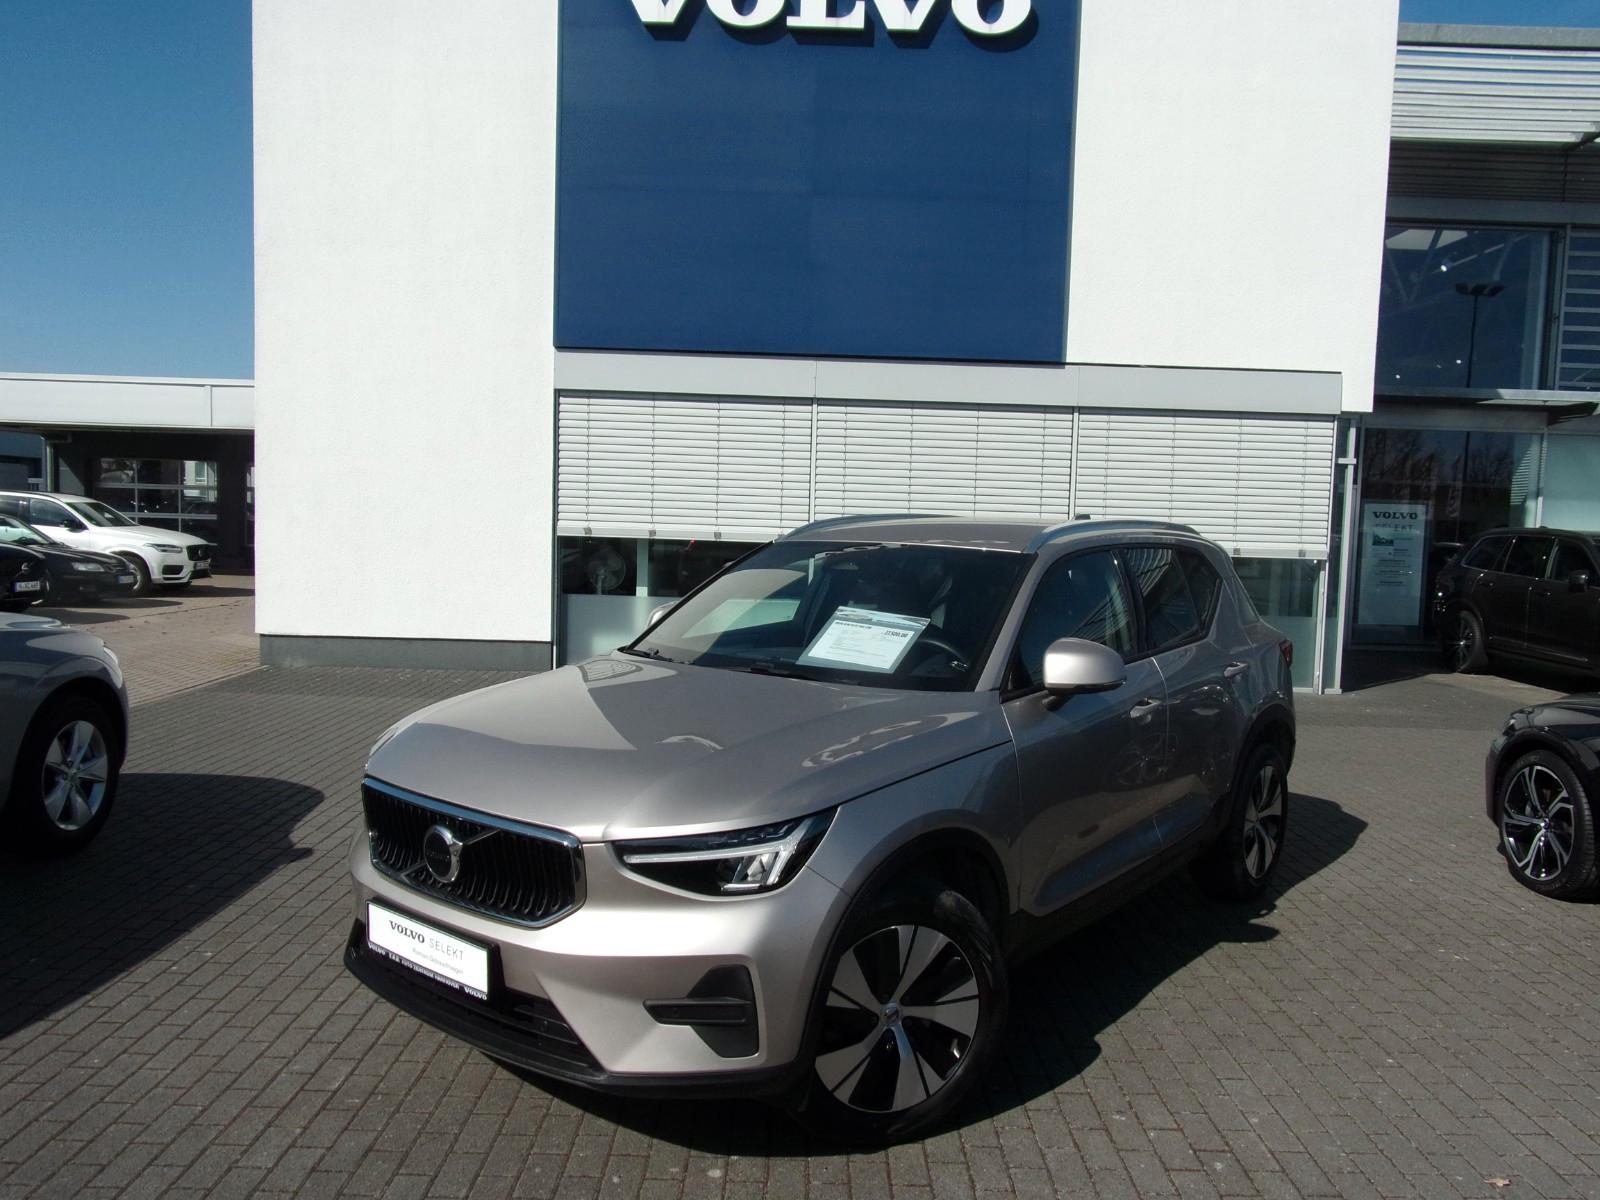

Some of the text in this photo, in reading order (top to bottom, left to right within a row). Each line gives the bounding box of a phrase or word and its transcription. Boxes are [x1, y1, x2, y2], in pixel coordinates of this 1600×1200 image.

[1372, 511, 1418, 520] VOLVO
[389, 920, 425, 943] VOLVO
[429, 938, 464, 960] SELEKT
[368, 942, 386, 956] VOLVO
[463, 986, 488, 1001] VOLVO
